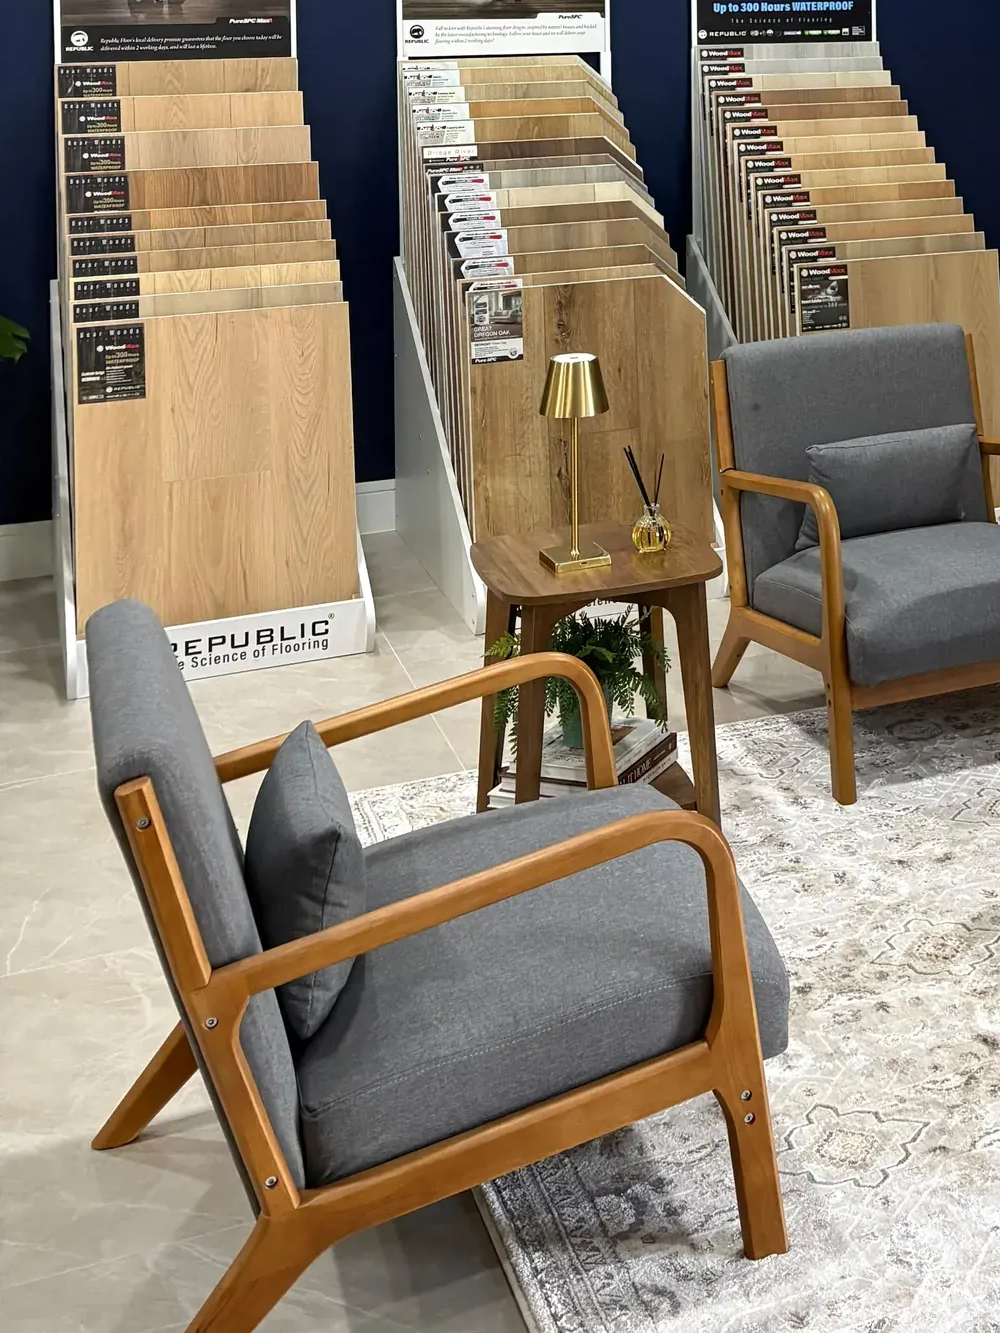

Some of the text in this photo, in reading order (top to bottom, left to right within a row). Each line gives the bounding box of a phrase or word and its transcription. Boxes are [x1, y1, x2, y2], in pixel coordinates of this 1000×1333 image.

[713, 1, 854, 14] Up to 300 Hours WATERPROOF
[191, 651, 247, 668] Science
[253, 646, 266, 658] of
[272, 638, 329, 656] Flooring
